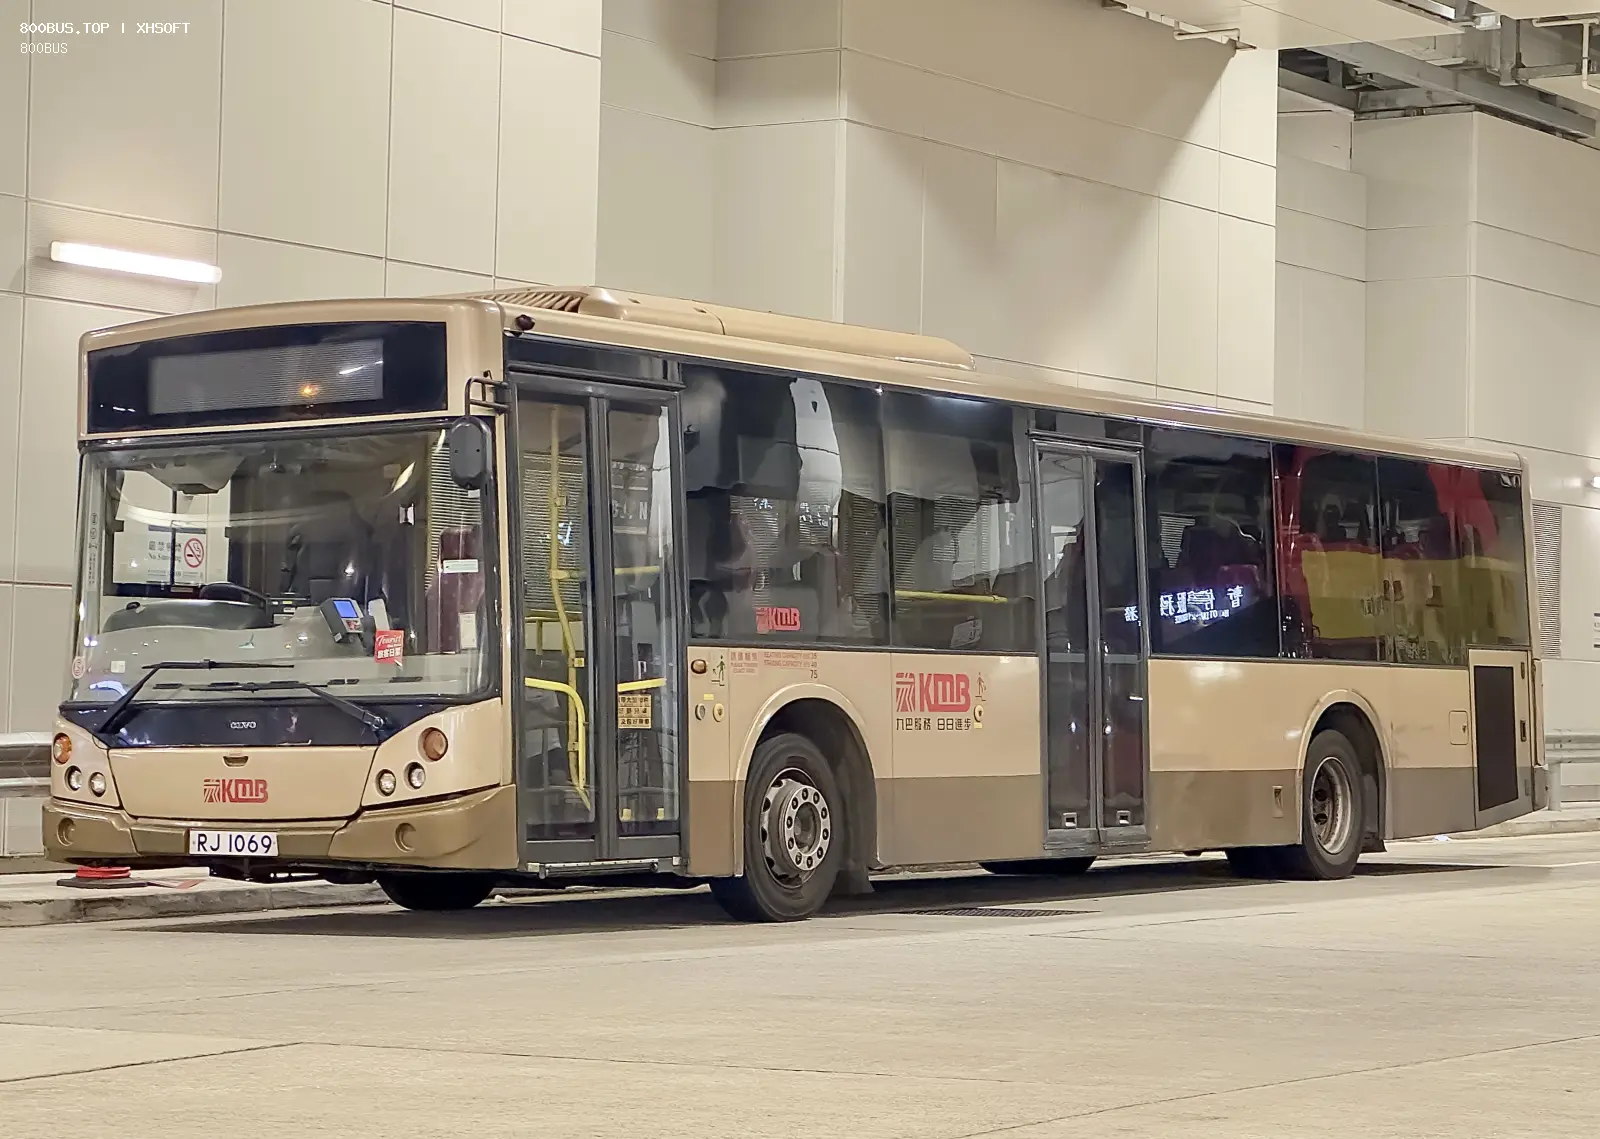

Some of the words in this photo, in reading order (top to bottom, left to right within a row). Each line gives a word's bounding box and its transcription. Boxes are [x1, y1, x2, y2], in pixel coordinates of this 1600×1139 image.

[768, 607, 800, 631] KMB
[810, 670, 818, 678] 75
[919, 673, 971, 712] KMB
[222, 778, 269, 803] KMB
[197, 833, 220, 852] RJ
[228, 833, 272, 854] 1069
